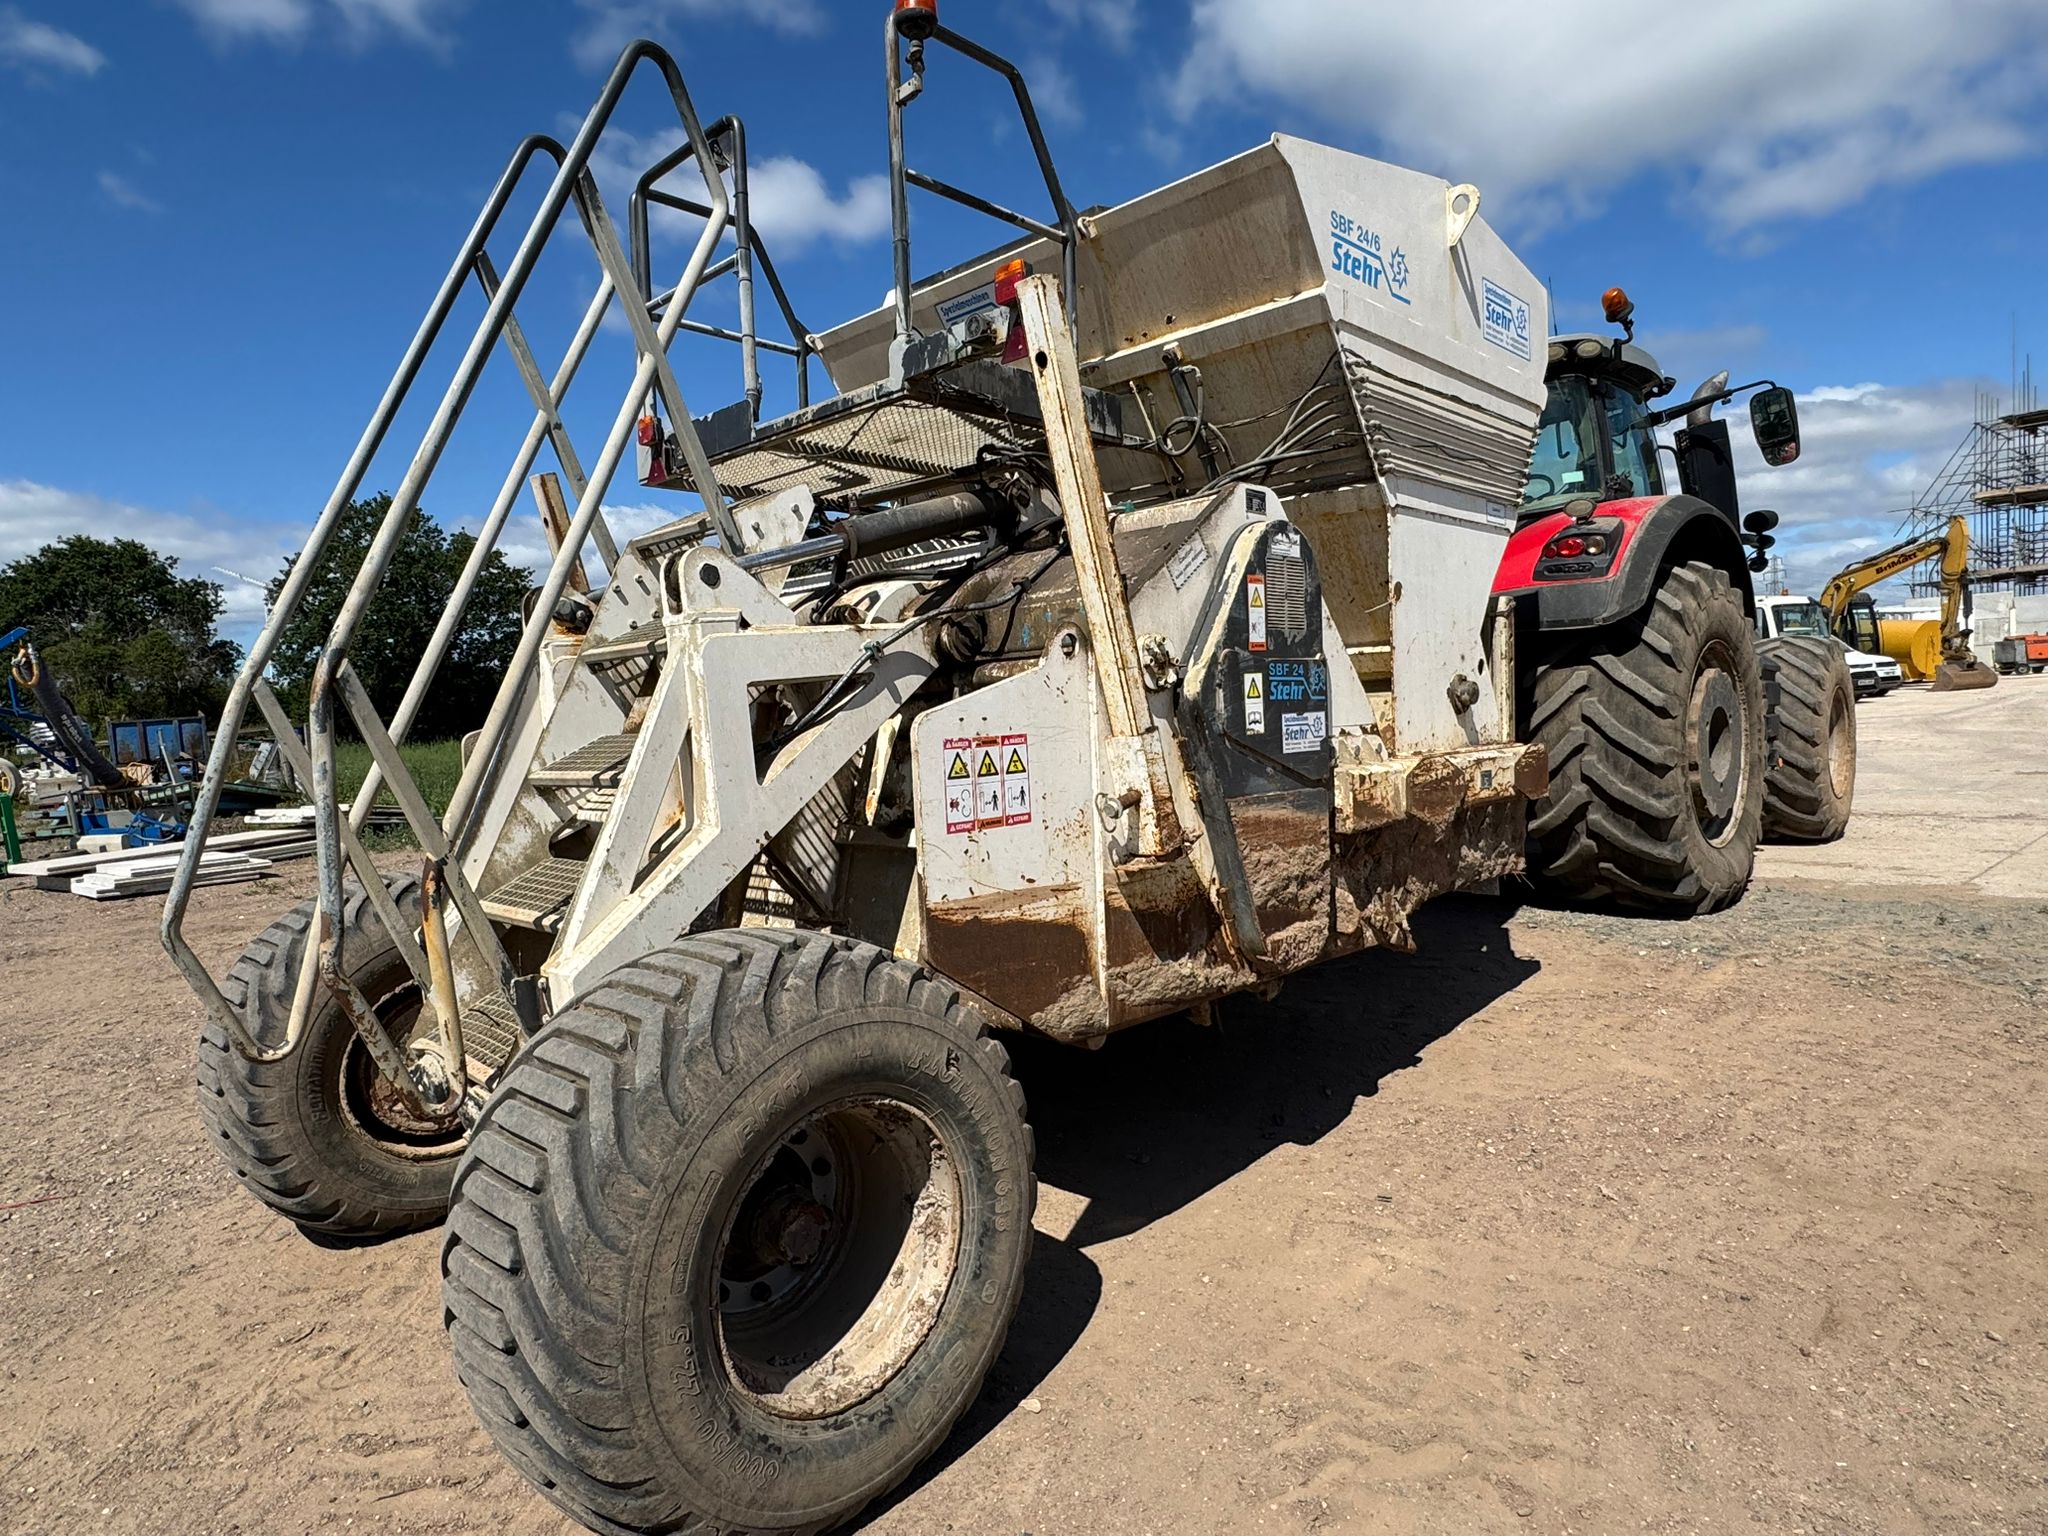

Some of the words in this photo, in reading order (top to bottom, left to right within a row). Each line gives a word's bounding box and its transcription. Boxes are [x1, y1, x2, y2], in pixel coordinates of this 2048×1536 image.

[1330, 209, 1354, 237] SBF
[1356, 225, 1382, 252] 24/6
[1331, 241, 1383, 290] Stehr
[1485, 302, 1512, 332] Stehr
[1268, 663, 1290, 676] SBF
[1292, 663, 1305, 676] 24
[1269, 681, 1305, 700] Stehr
[1284, 727, 1309, 741] Stehr
